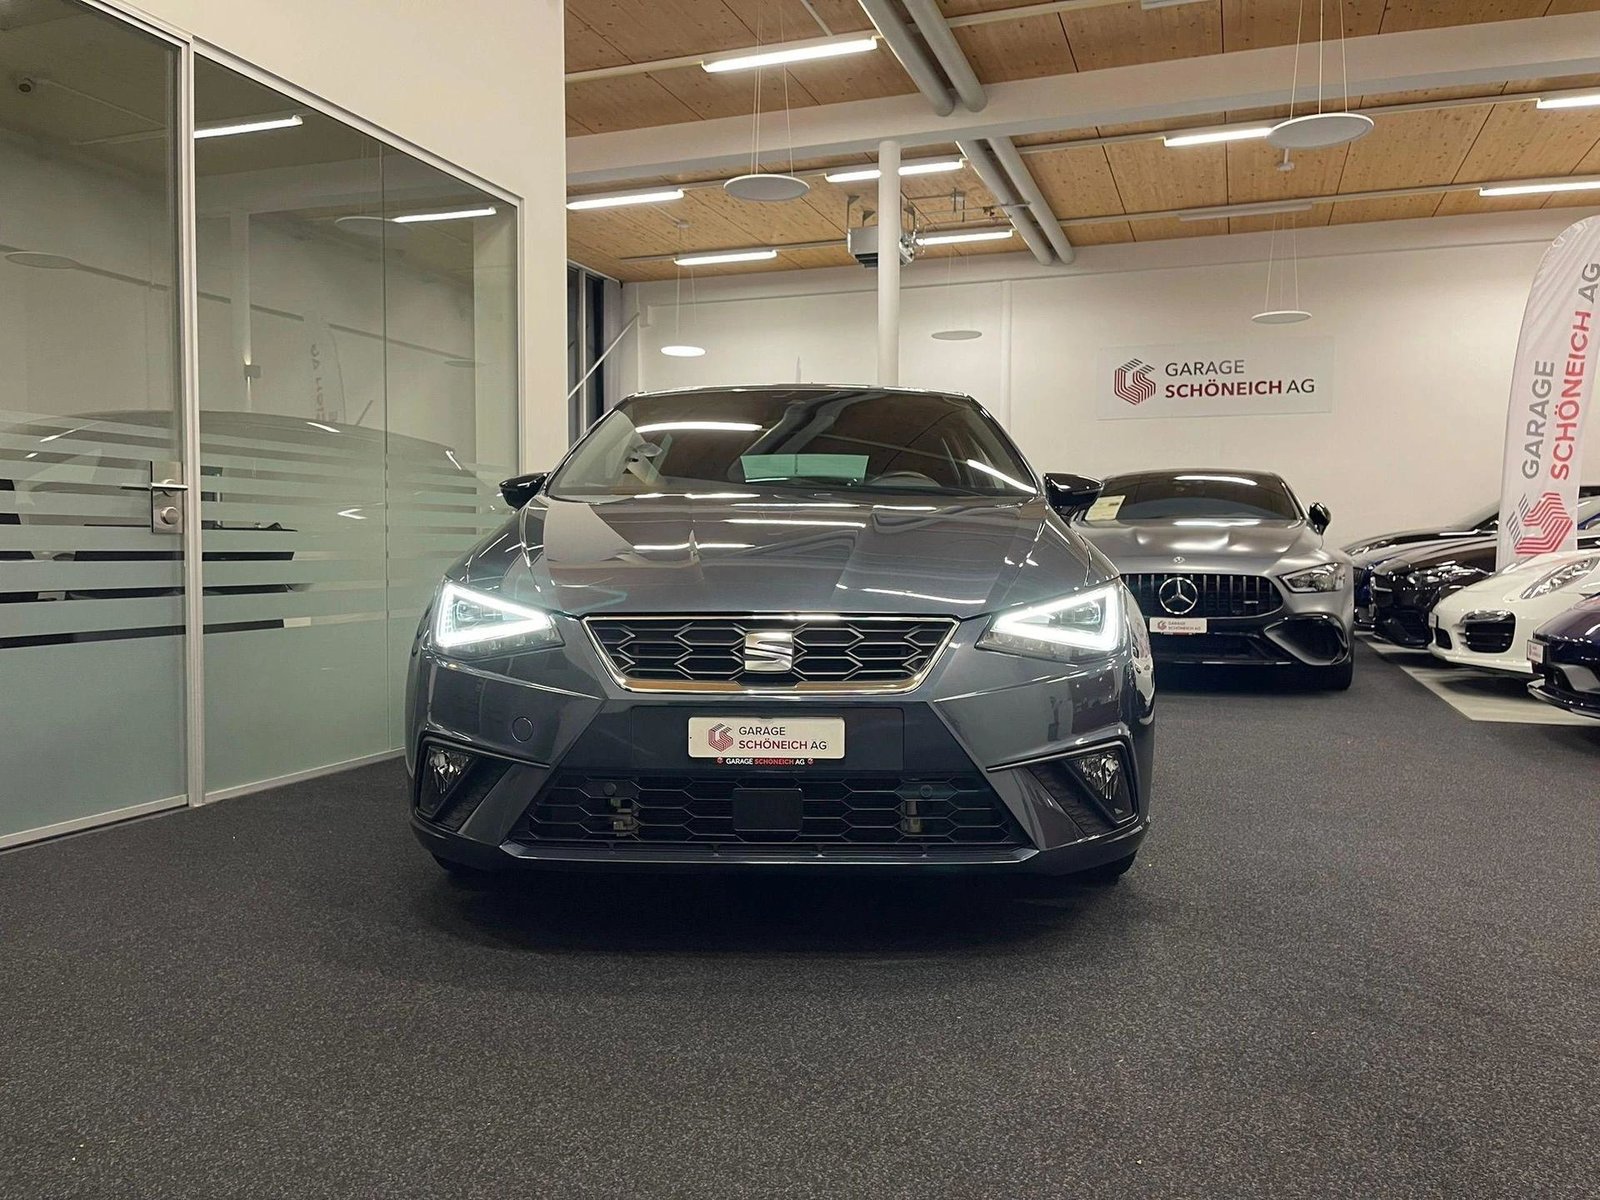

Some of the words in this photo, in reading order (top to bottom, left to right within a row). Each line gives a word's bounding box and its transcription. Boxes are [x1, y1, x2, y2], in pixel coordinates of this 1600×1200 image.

[1165, 360, 1245, 377] GARAGE
[1550, 310, 1592, 481] SCHÖNEICH
[1577, 263, 1600, 304] AG
[1165, 379, 1282, 398] SCHÖNEICH
[1286, 378, 1315, 394] AG
[1521, 360, 1555, 480] GARAGE
[738, 726, 786, 736] GARAGE
[738, 738, 808, 750] SCHÖNEICH
[810, 741, 827, 751] AG
